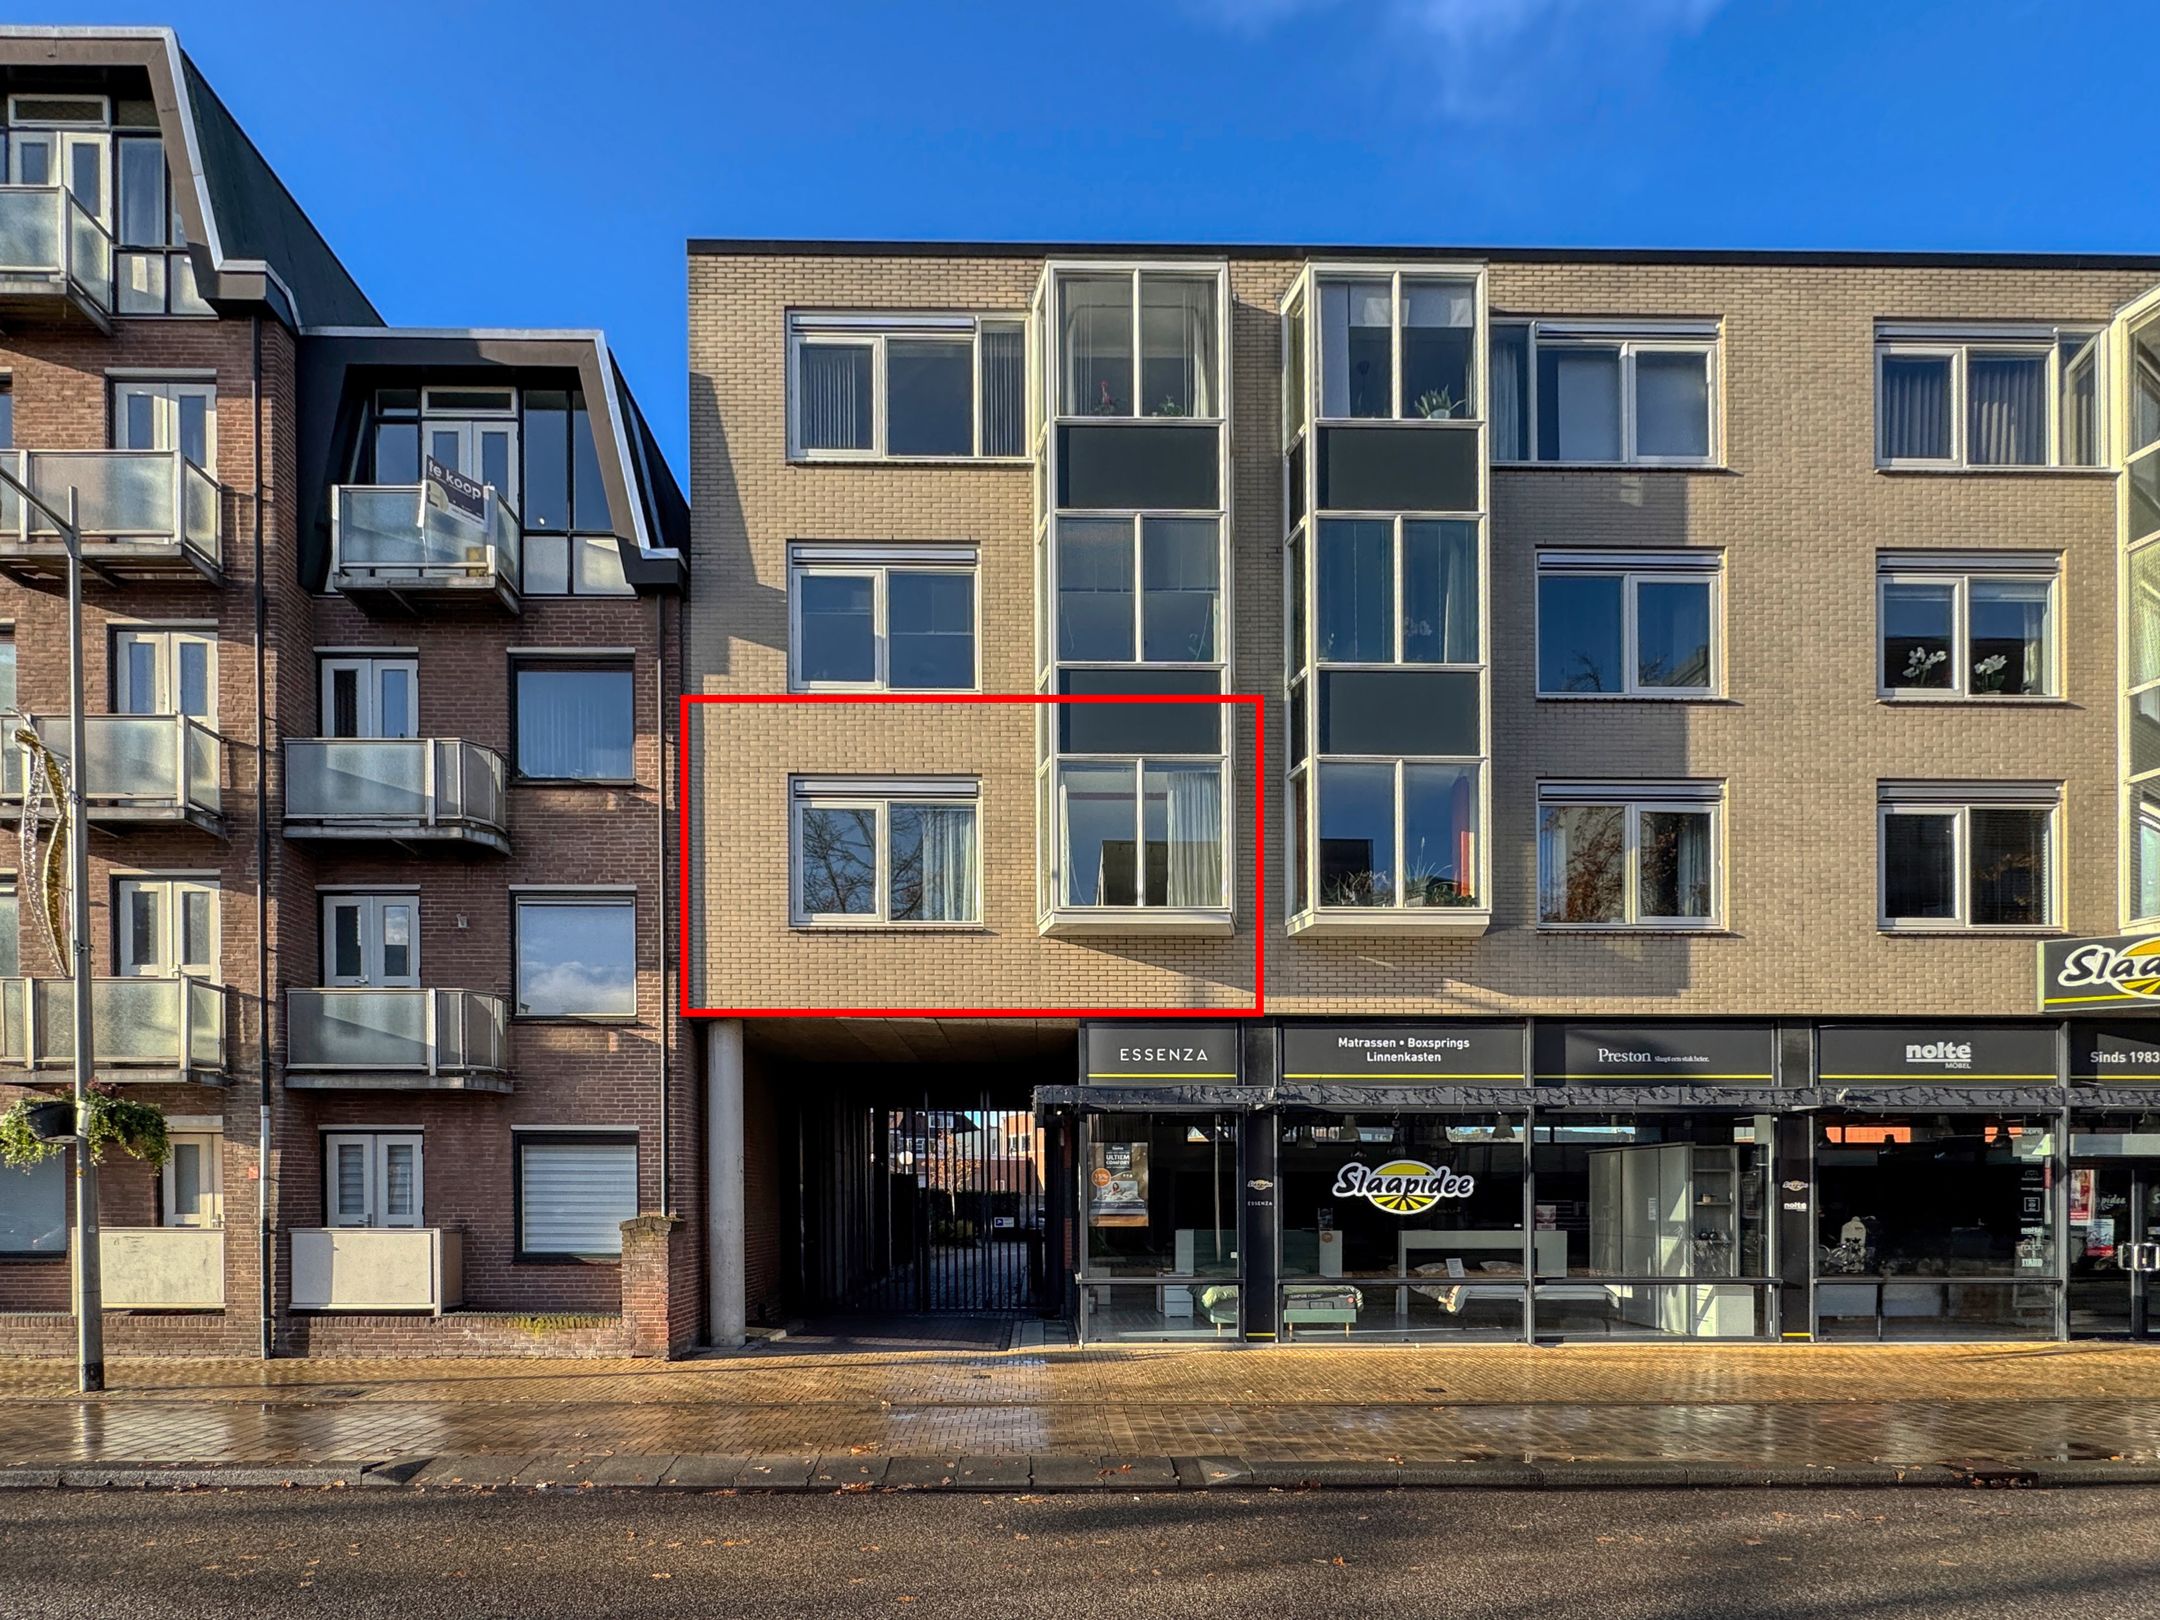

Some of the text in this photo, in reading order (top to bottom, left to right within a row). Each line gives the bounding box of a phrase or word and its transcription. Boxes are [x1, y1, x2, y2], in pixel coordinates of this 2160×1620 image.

[428, 460, 482, 500] te koop
[1338, 1037, 1470, 1050] Matrassen Boxsprings
[1906, 1042, 1971, 1058] nolte
[1120, 1048, 1208, 1061] ESSENZA
[1366, 1051, 1442, 1062] Linnenkasten
[1598, 1048, 1652, 1063] Preston
[2090, 1051, 2160, 1063] Sinds 1983
[1334, 1163, 1471, 1201] Slaapidee
